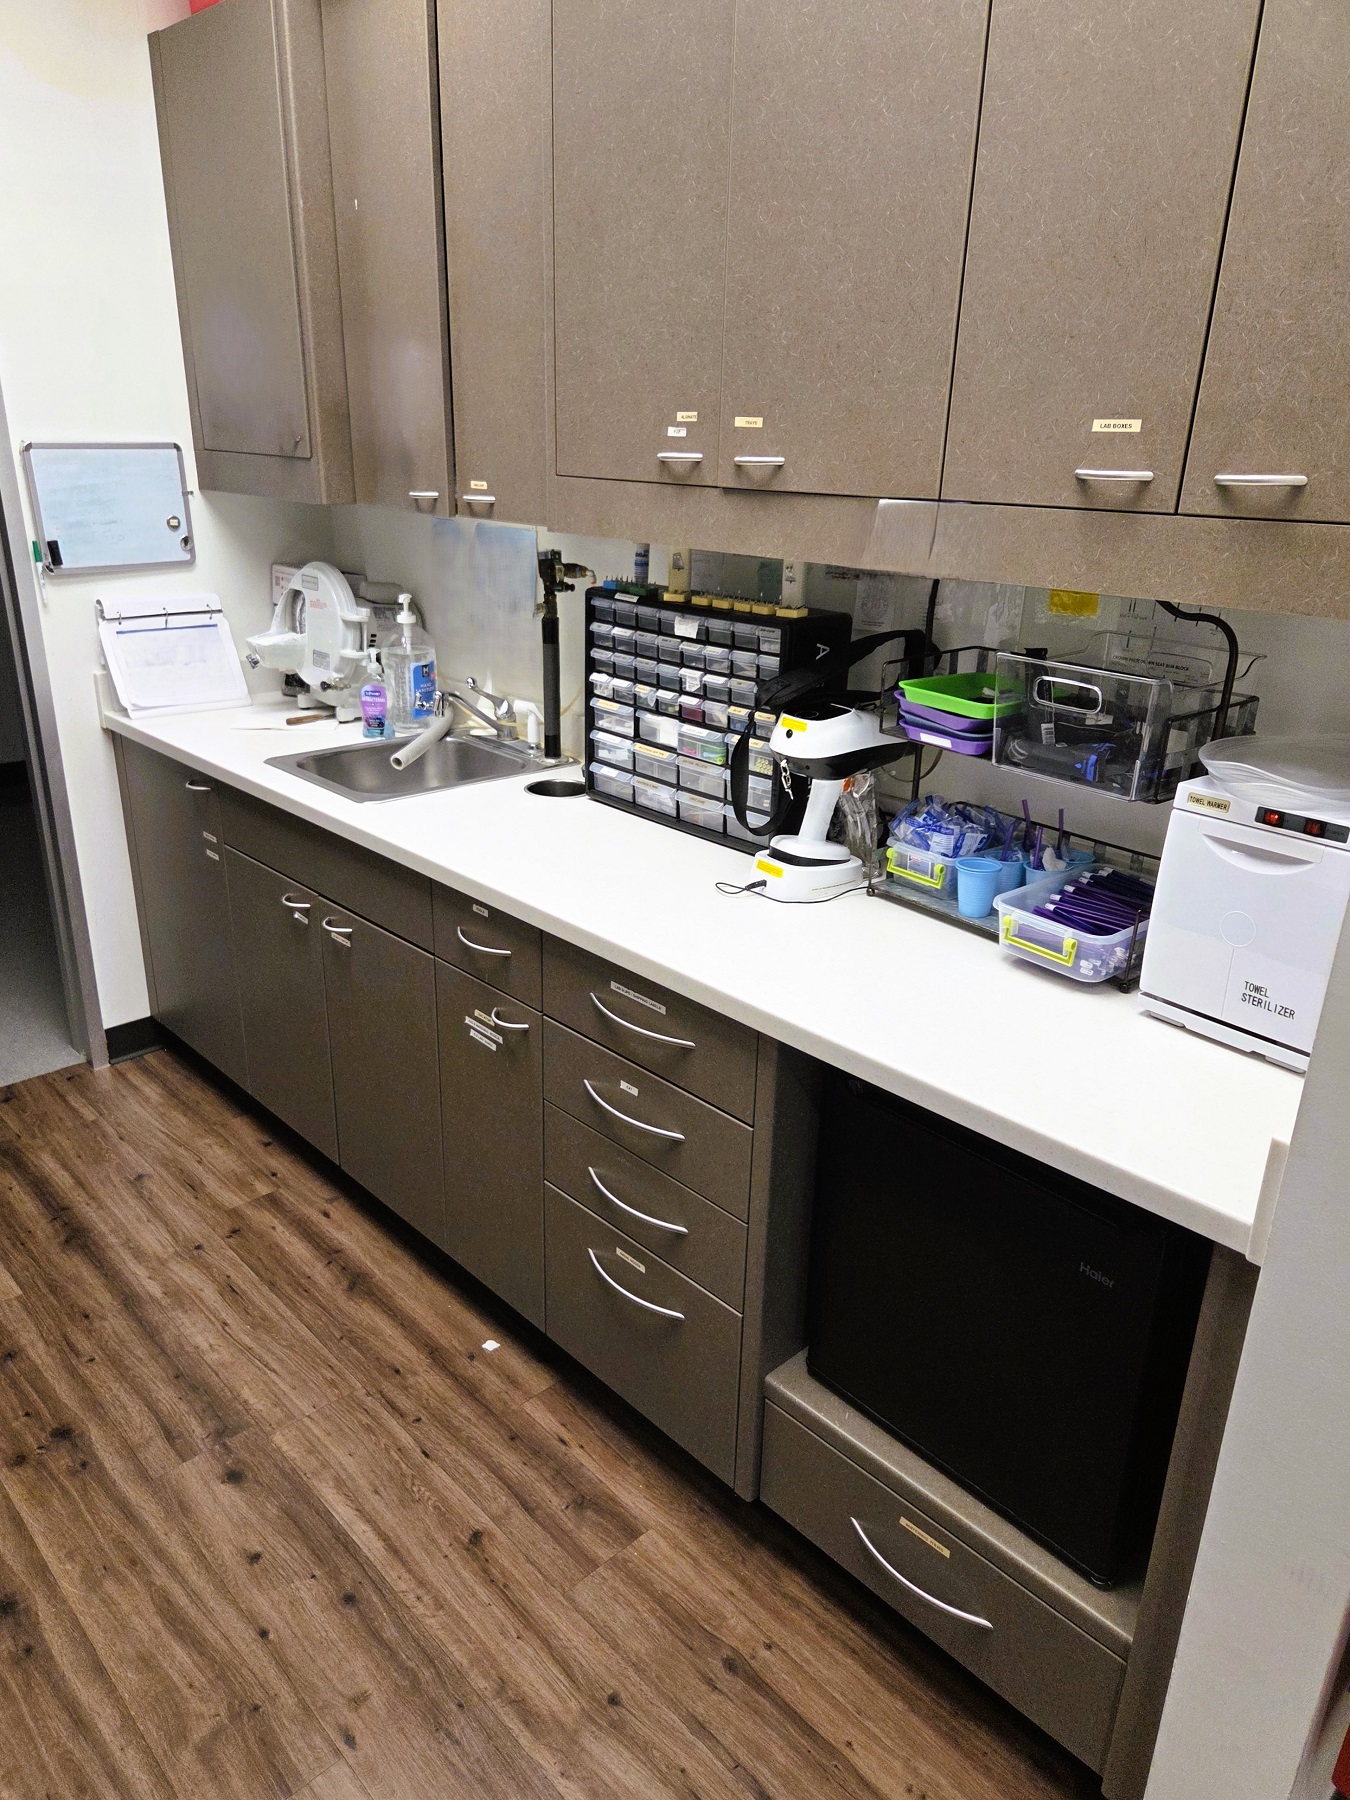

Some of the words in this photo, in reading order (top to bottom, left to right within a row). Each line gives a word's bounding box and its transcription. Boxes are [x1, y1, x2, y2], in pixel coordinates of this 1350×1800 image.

[1189, 796, 1205, 805] TOWEL
[1206, 800, 1228, 811] WARMER
[1244, 980, 1269, 998] TOWEL
[1241, 992, 1296, 1020] STERILIZER
[1079, 1261, 1116, 1288] Haier
